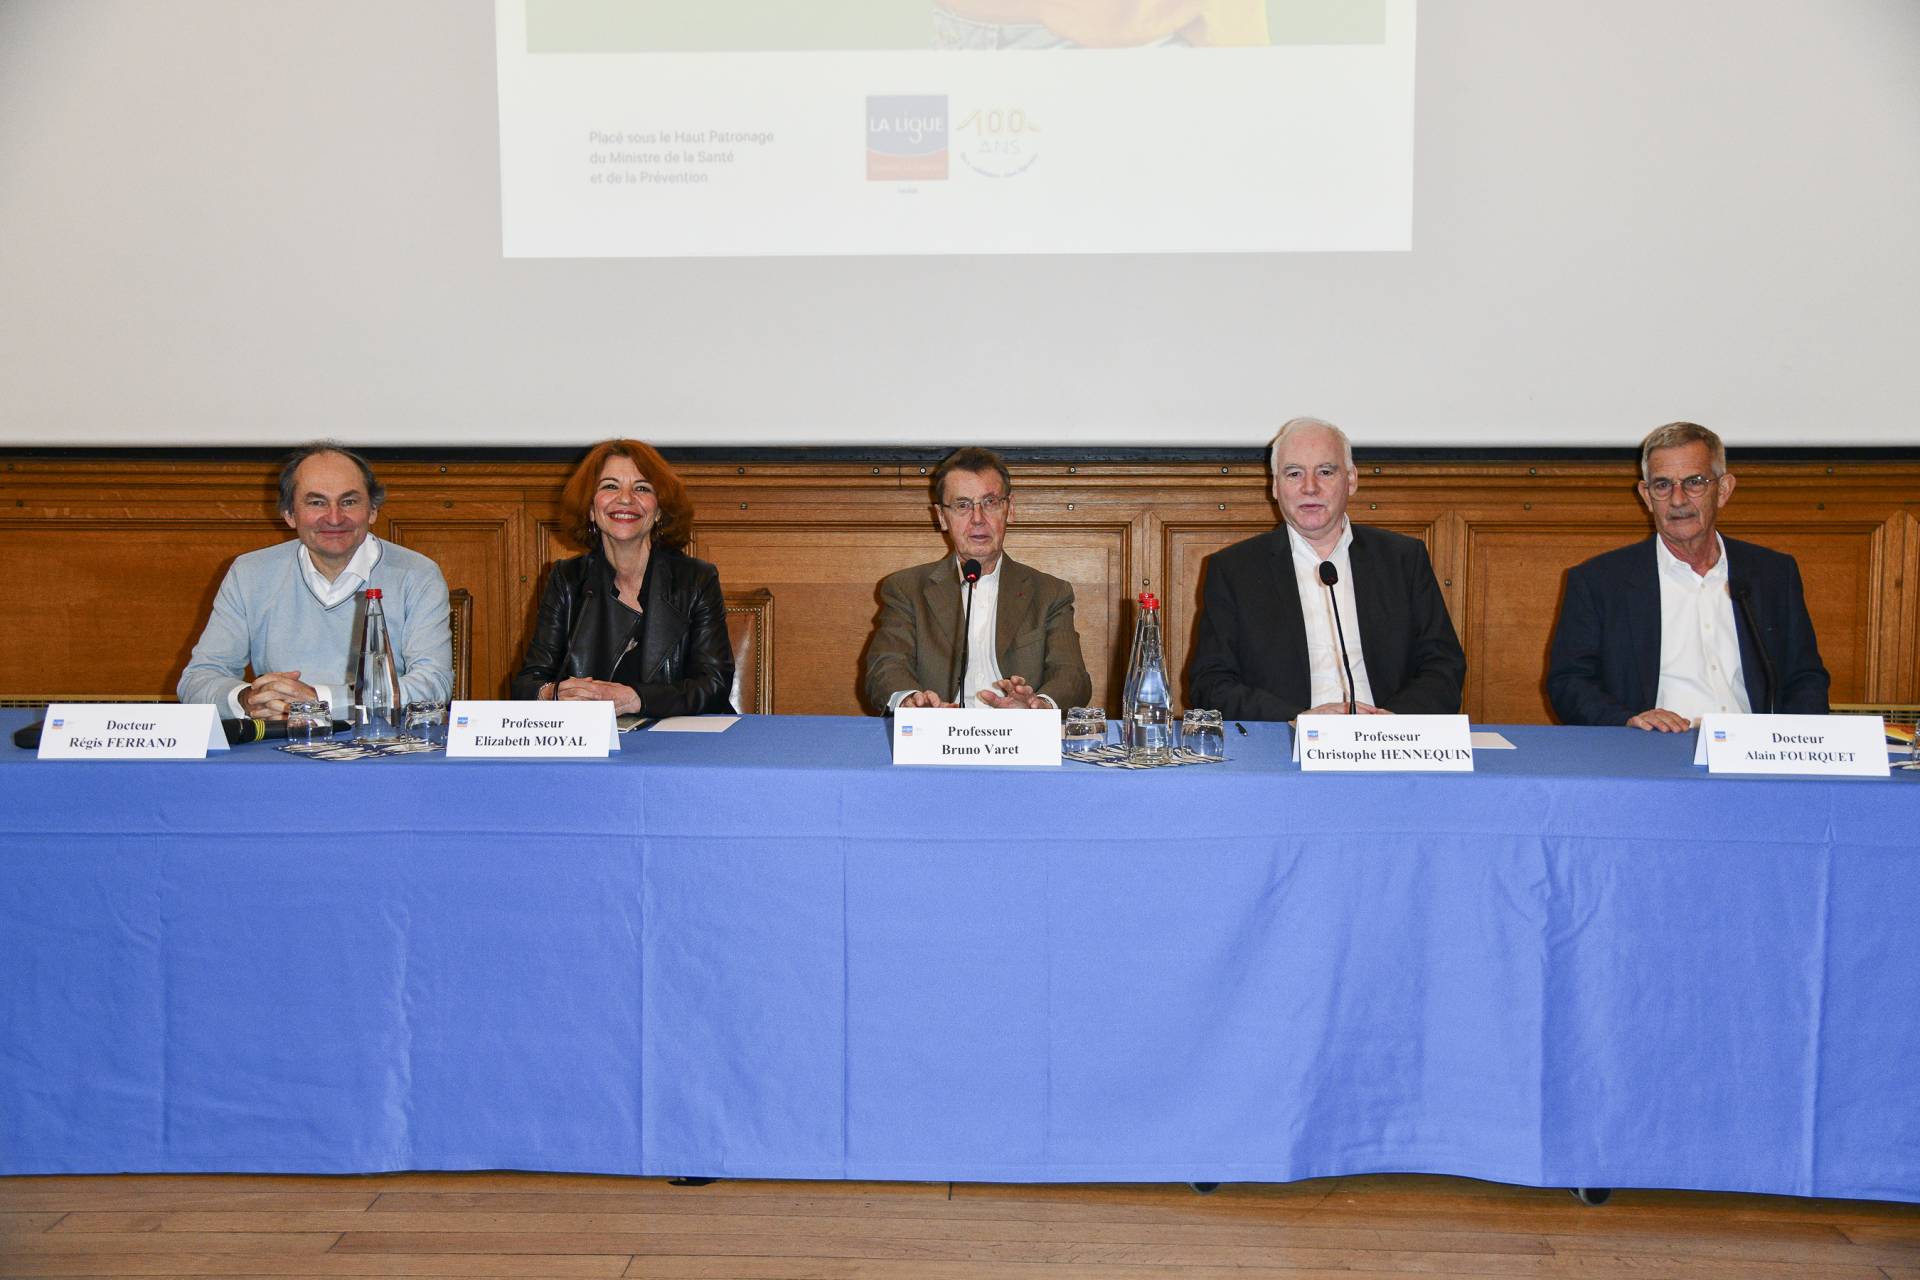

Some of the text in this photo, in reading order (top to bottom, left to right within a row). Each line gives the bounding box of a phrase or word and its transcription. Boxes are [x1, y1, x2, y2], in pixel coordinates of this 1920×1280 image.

[870, 117, 890, 132] LA
[957, 108, 1026, 136] 100
[589, 130, 775, 145] Placé sous le Haut Patronage
[978, 139, 1021, 153] ANS
[589, 150, 735, 164] du Ministre de la Santé
[589, 170, 708, 184] et de la Prévention
[106, 720, 157, 731] Docteur
[501, 717, 565, 729] Professeur
[948, 725, 1013, 737] Professeur
[1354, 731, 1421, 742] Professeur
[69, 737, 177, 750] Régis FERRAND
[474, 735, 587, 747] Elizabeth MOYAL
[1772, 732, 1825, 744] Docteur
[942, 744, 1019, 756] Bruno Varet
[1306, 748, 1471, 762] Christophe HENNEQUIN
[1745, 750, 1856, 763] Alain FOURQUET
